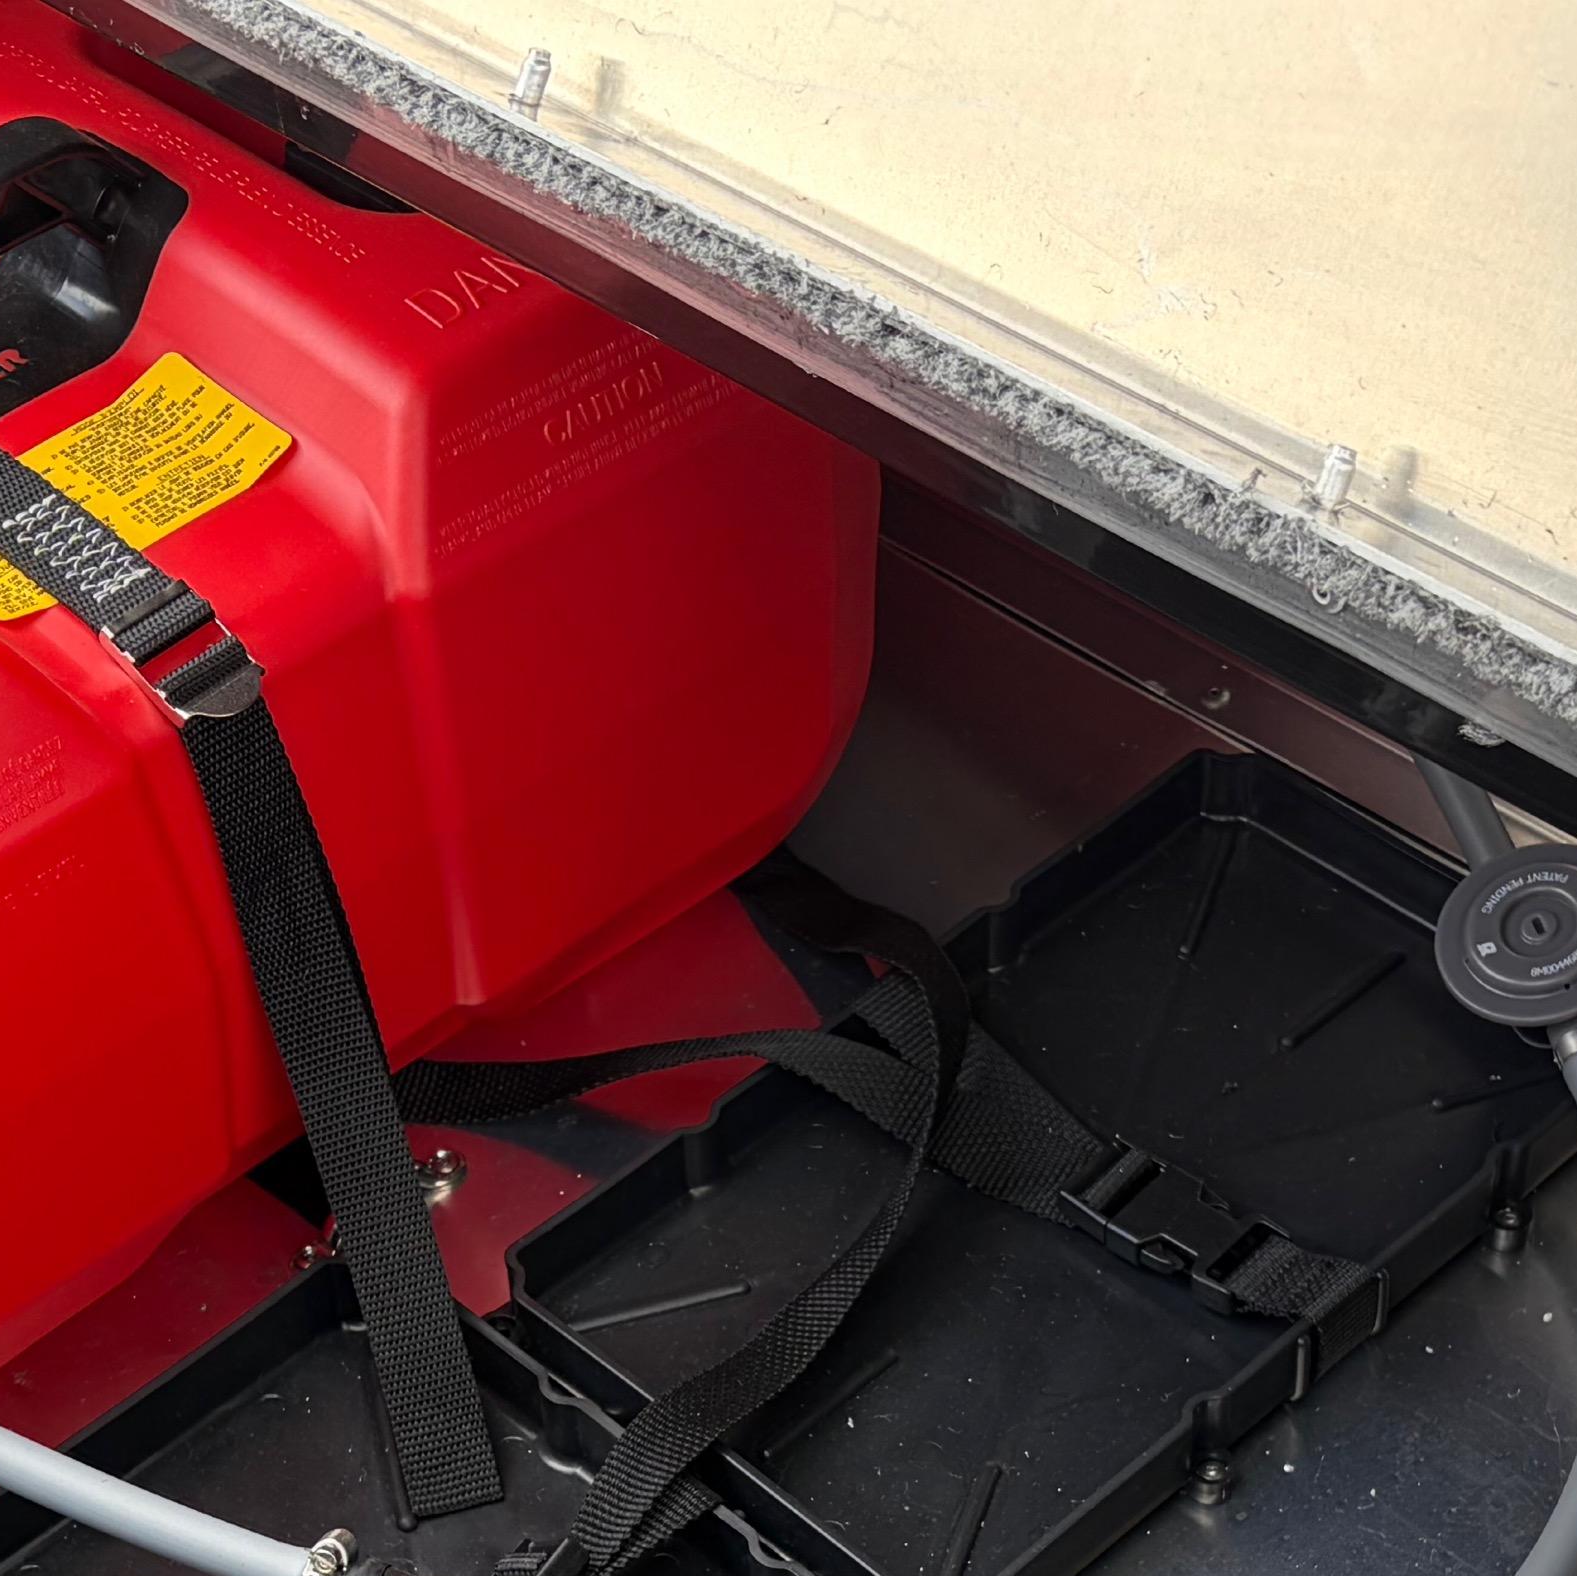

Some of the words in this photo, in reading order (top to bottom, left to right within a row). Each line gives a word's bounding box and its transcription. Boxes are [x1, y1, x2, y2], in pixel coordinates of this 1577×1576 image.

[405, 254, 536, 329] DAN
[543, 362, 664, 445] CAUTION
[1480, 877, 1524, 915] PENDING
[1525, 870, 1569, 884] PATENT
